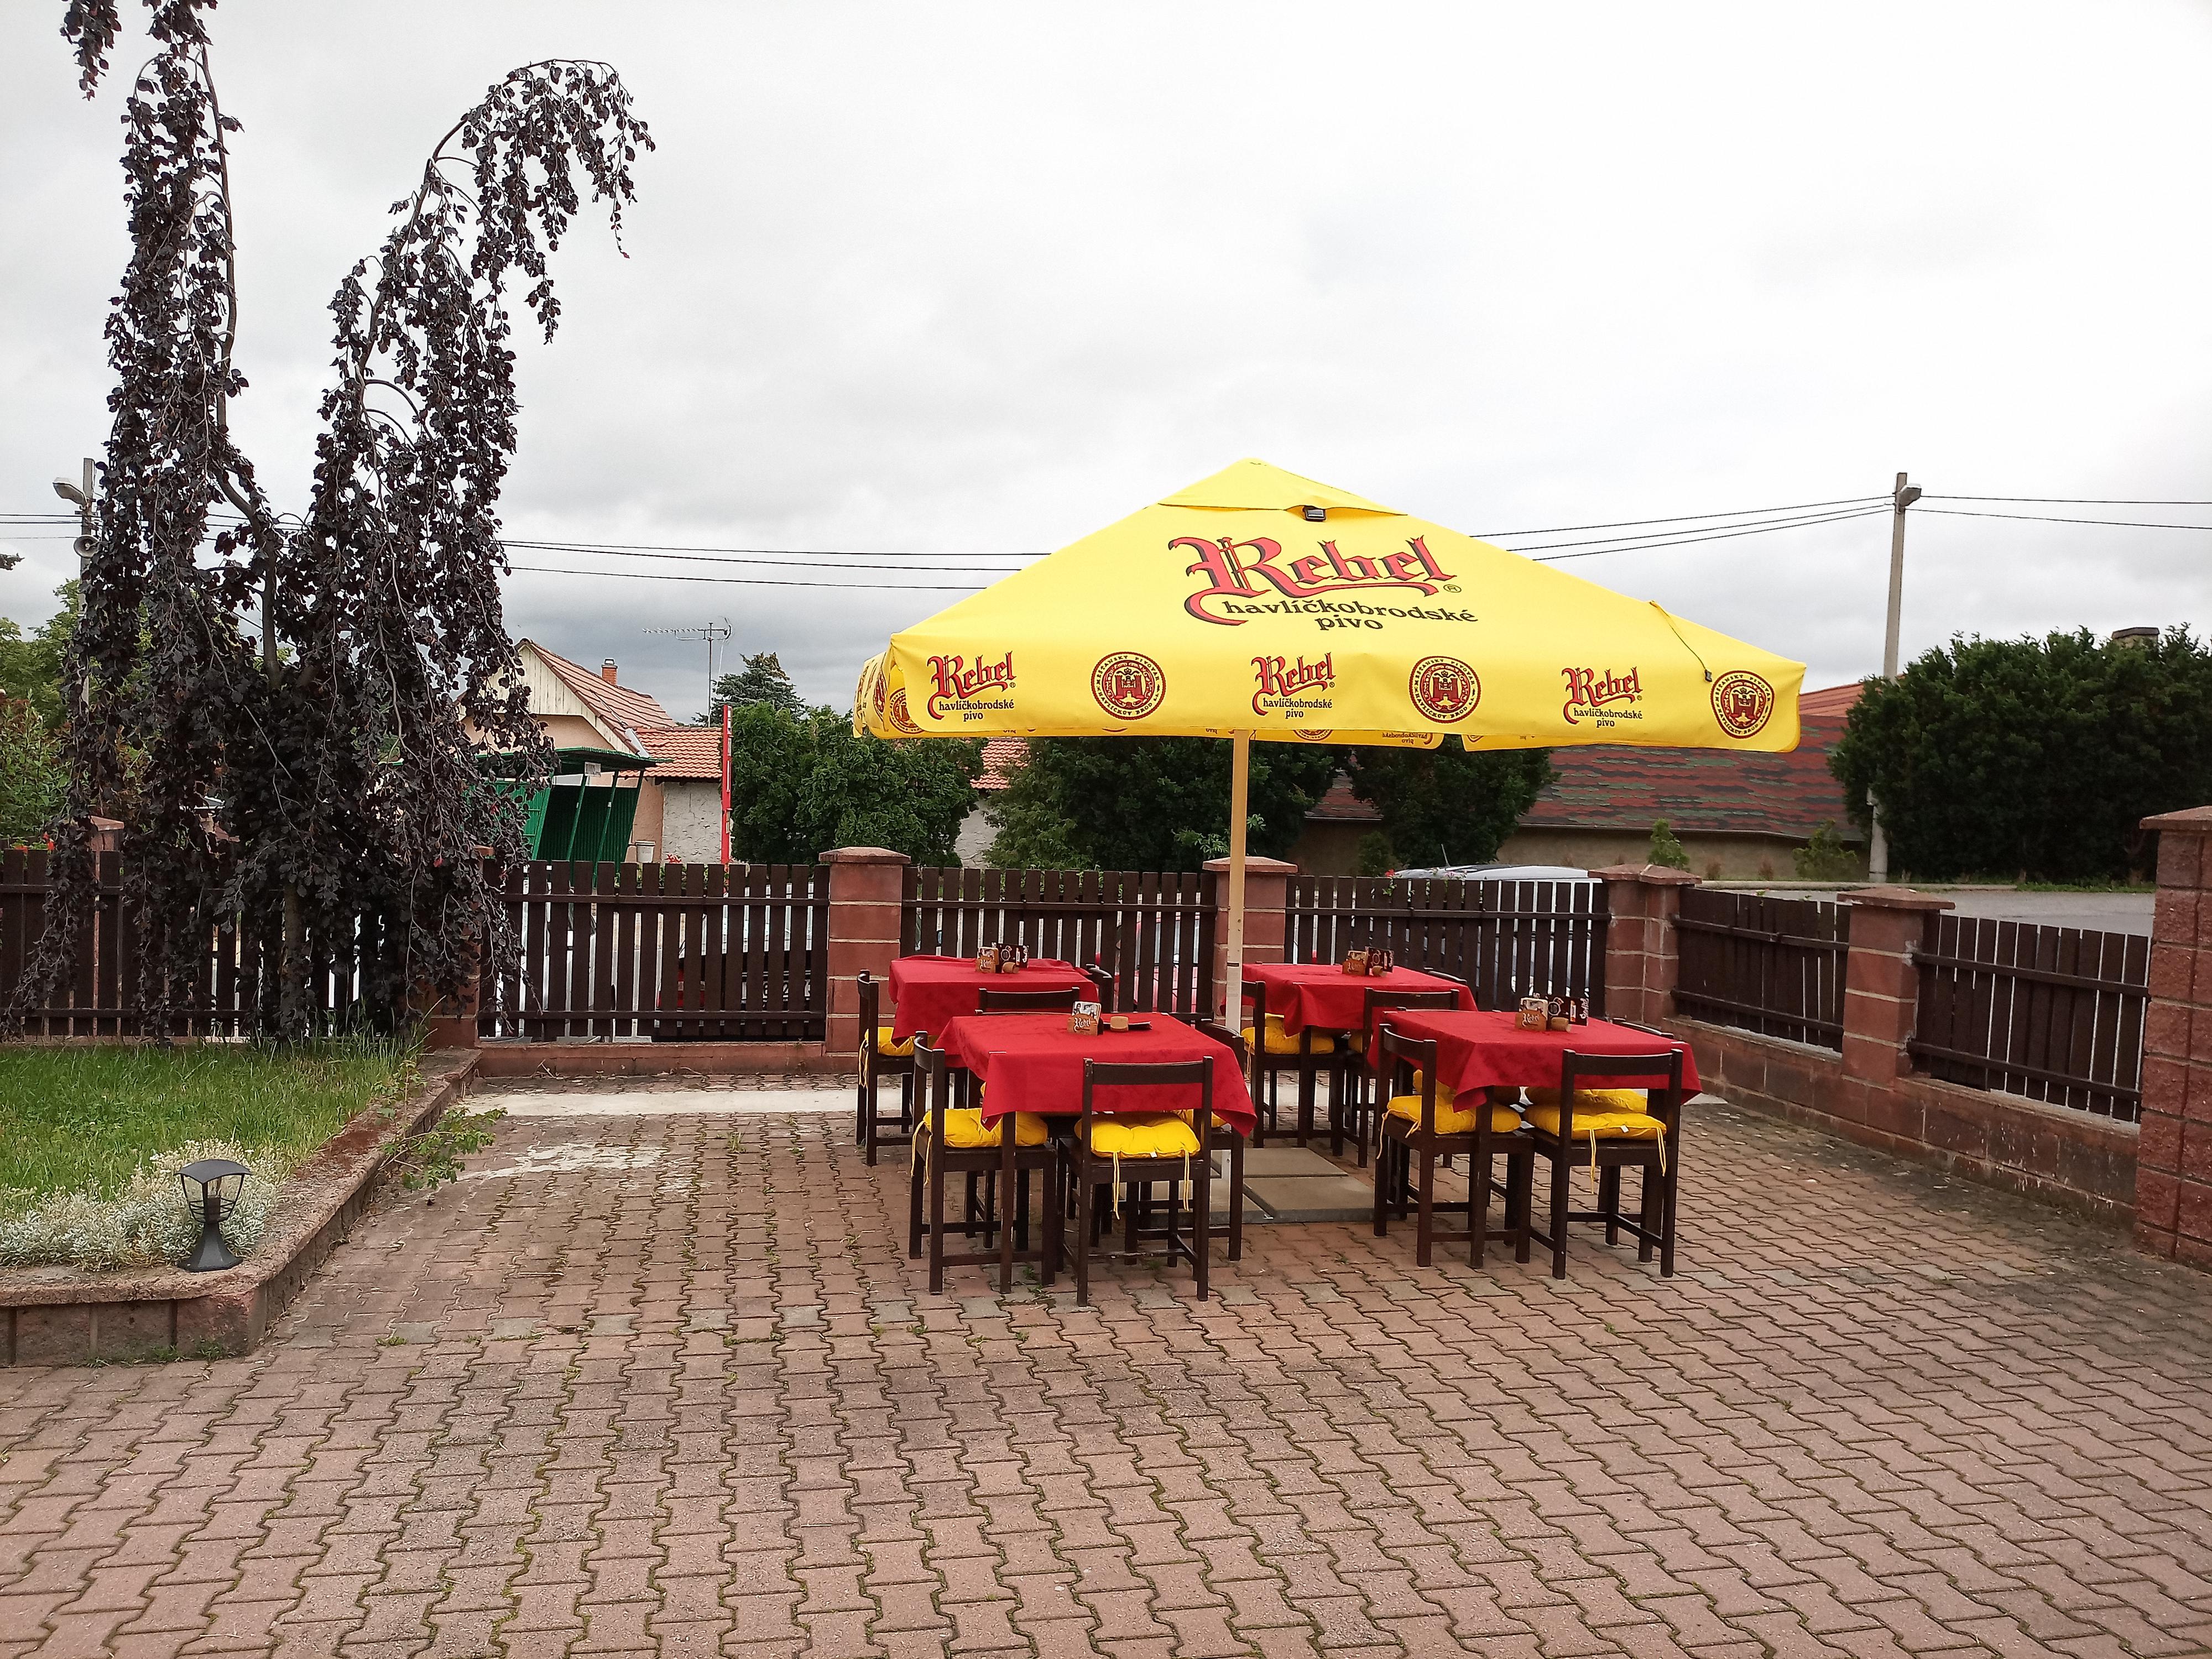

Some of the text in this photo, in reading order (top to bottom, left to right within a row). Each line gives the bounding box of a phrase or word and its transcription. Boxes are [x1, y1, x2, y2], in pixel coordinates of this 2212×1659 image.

[1168, 535, 1457, 626] Rebel
[1222, 599, 1479, 622] havlíčkobrodské
[1314, 614, 1384, 632] pivo
[927, 650, 1016, 720] Rebel
[1251, 652, 1336, 716] Rebel
[1562, 666, 1643, 725] Rebel
[938, 699, 1015, 711] havlíčkobrodské
[1135, 702, 1152, 714] BROD
[1263, 697, 1333, 708] havlíčkobrodské
[963, 711, 984, 722] pivo
[1285, 708, 1304, 719] pivo
[1573, 707, 1642, 719] havlíčkobrodské
[1596, 718, 1615, 728] pivo
